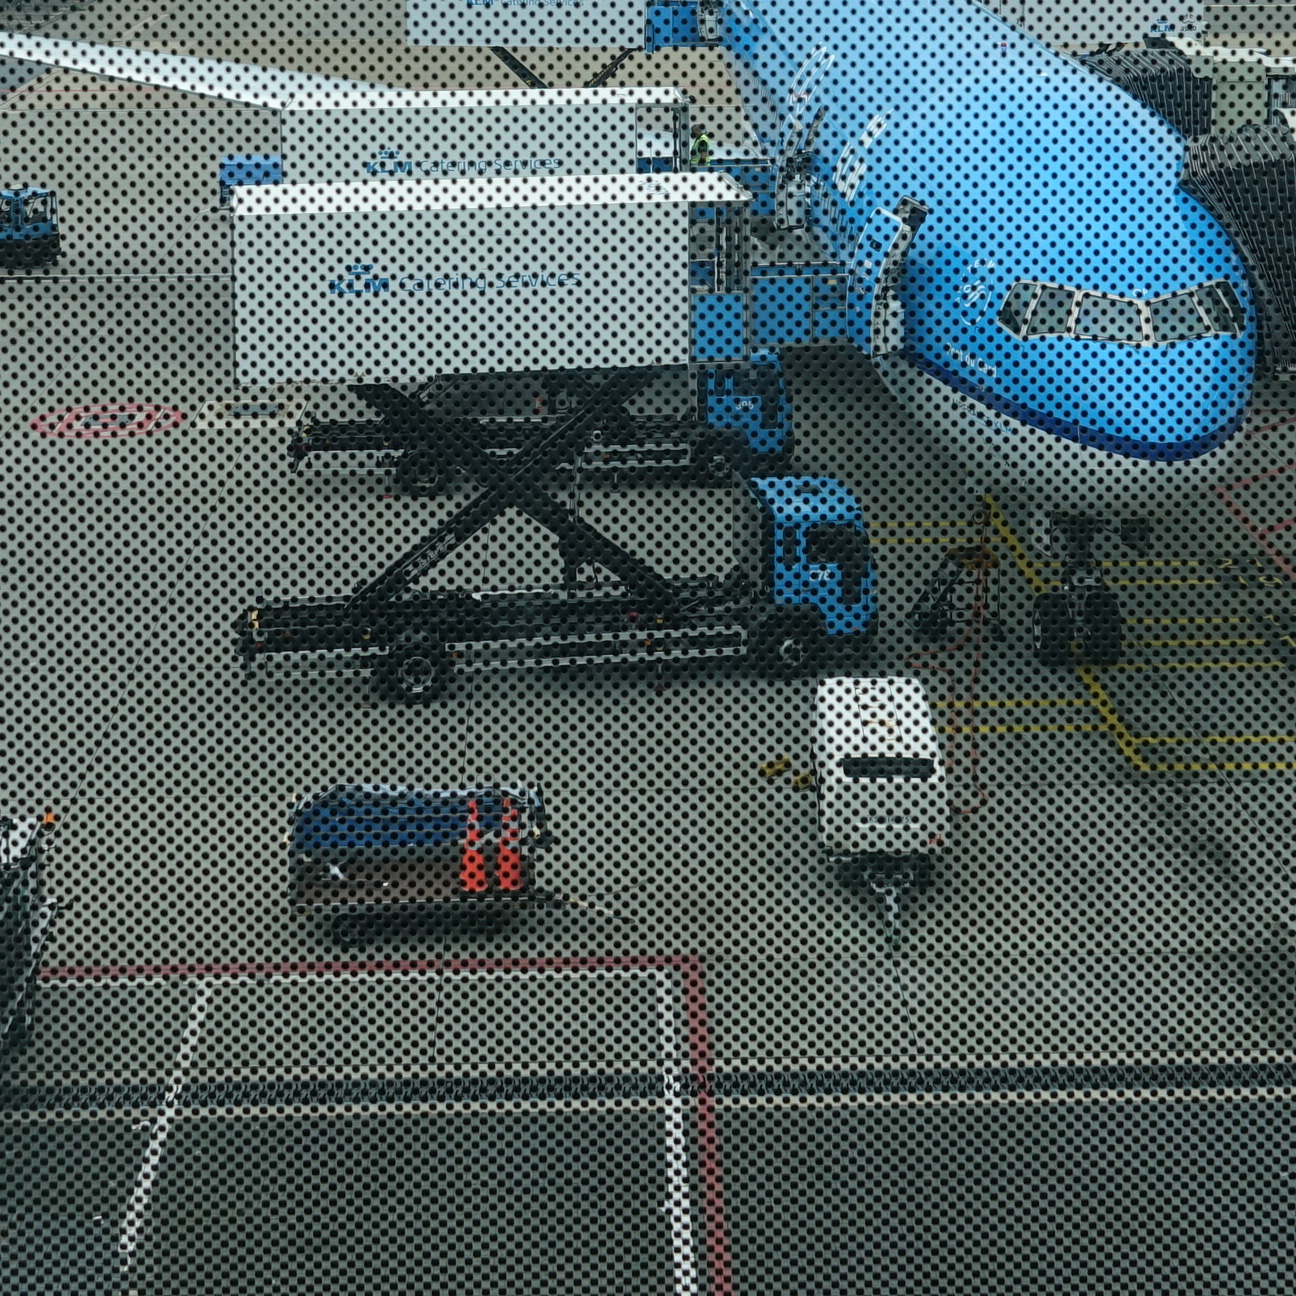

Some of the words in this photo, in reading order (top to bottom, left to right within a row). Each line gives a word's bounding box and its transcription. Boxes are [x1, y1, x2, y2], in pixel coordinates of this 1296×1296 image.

[366, 160, 412, 174] KLM
[420, 158, 487, 174] Catering
[494, 156, 562, 171] Services
[329, 277, 390, 294] KLM
[400, 274, 487, 292] Catering
[496, 270, 580, 290] Services
